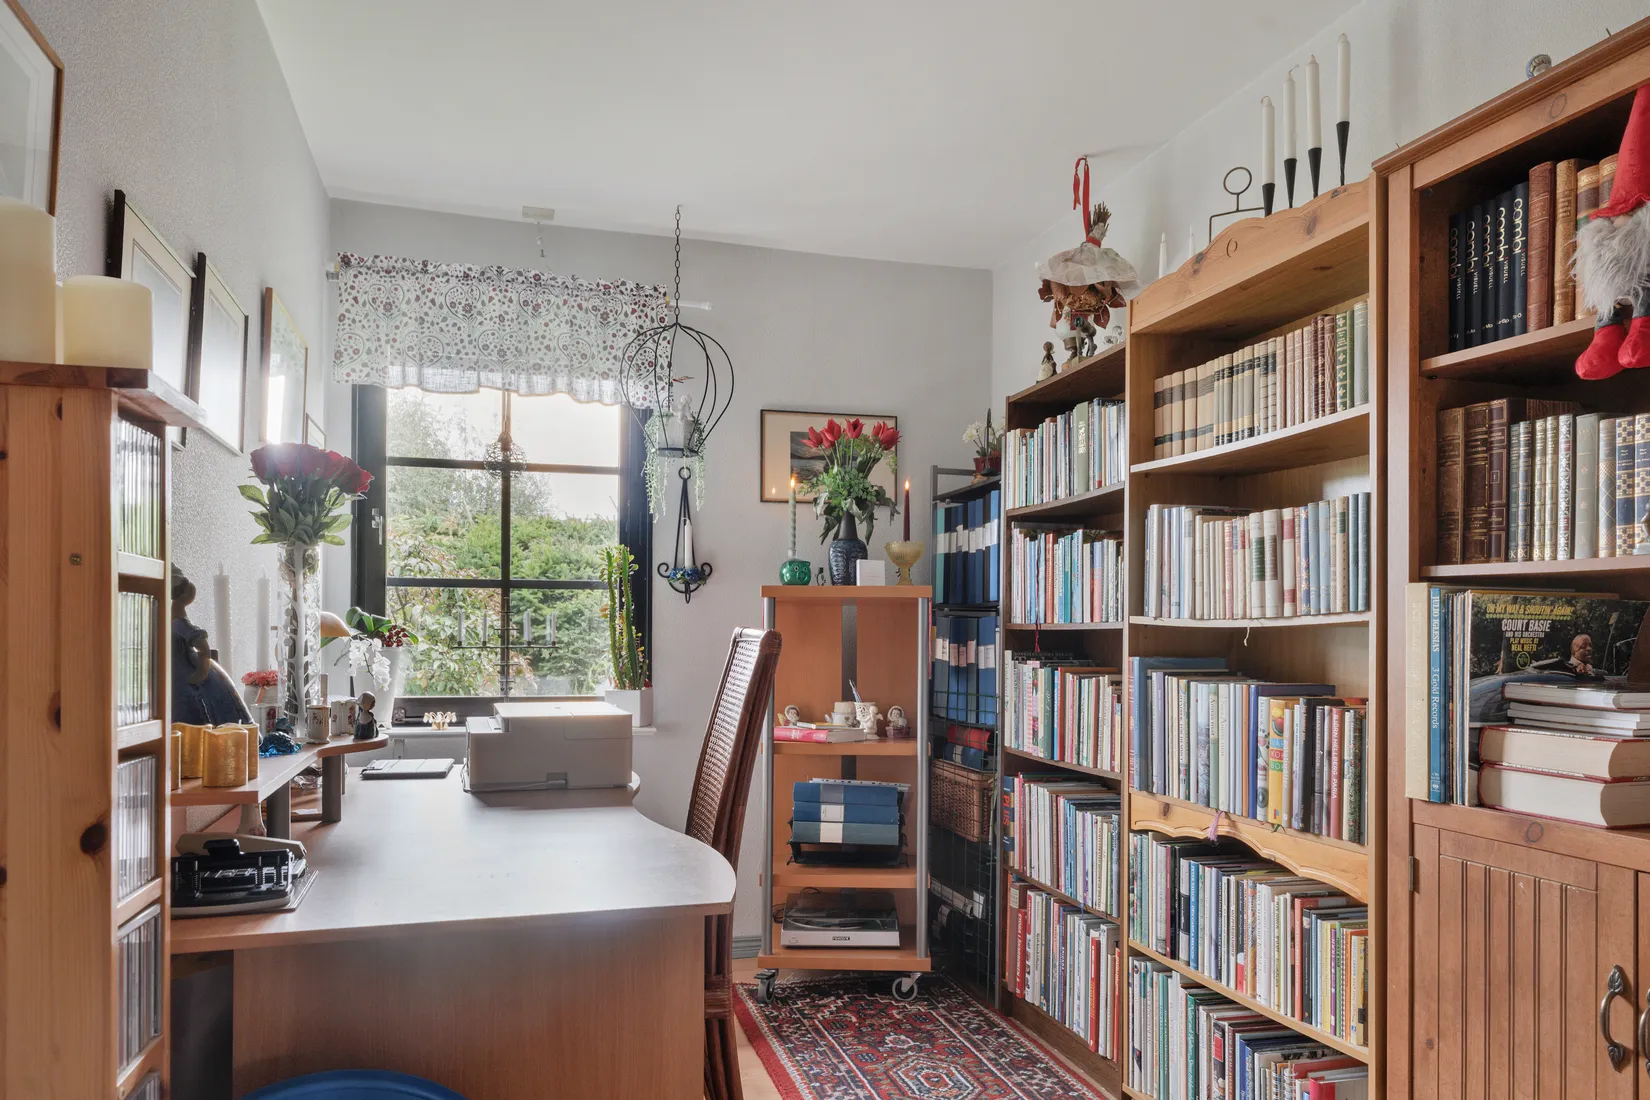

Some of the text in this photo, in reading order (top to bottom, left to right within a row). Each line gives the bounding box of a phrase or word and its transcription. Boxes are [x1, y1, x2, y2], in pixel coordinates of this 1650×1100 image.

[1483, 214, 1494, 268] combi
[1496, 207, 1508, 263] combi
[1513, 198, 1526, 255] combi
[1467, 221, 1478, 274] combi
[1431, 596, 1440, 617] JULIO
[1506, 604, 1519, 613] WAY
[1432, 619, 1440, 653] IGLESIAS
[1501, 619, 1552, 632] COUNT BASIE
[1432, 674, 1440, 694] Gold
[1432, 696, 1440, 729] Records
[1003, 794, 1011, 826] PLUS
